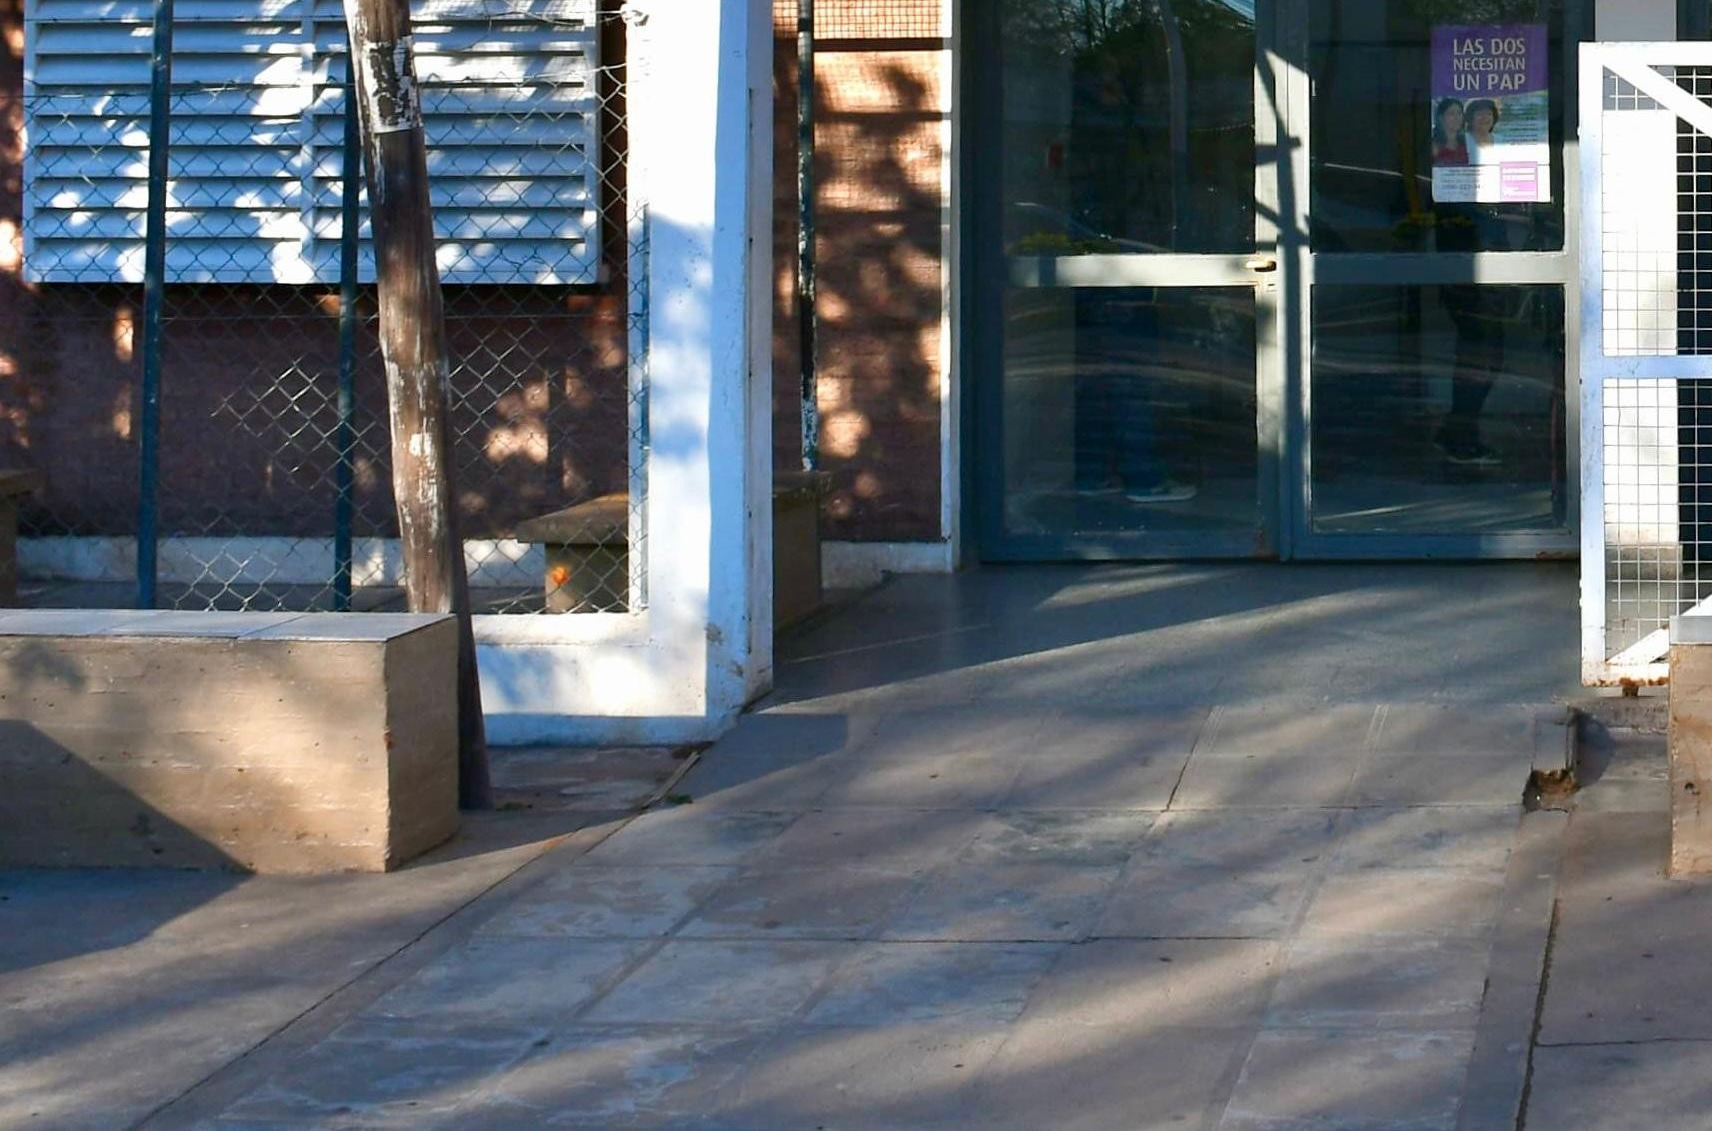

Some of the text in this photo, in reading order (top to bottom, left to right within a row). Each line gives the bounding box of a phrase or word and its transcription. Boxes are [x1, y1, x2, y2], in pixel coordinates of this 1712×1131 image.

[1453, 38, 1526, 56] LAS DOS
[1453, 57, 1526, 71] NECESITAN
[1453, 73, 1526, 91] UN PAP
